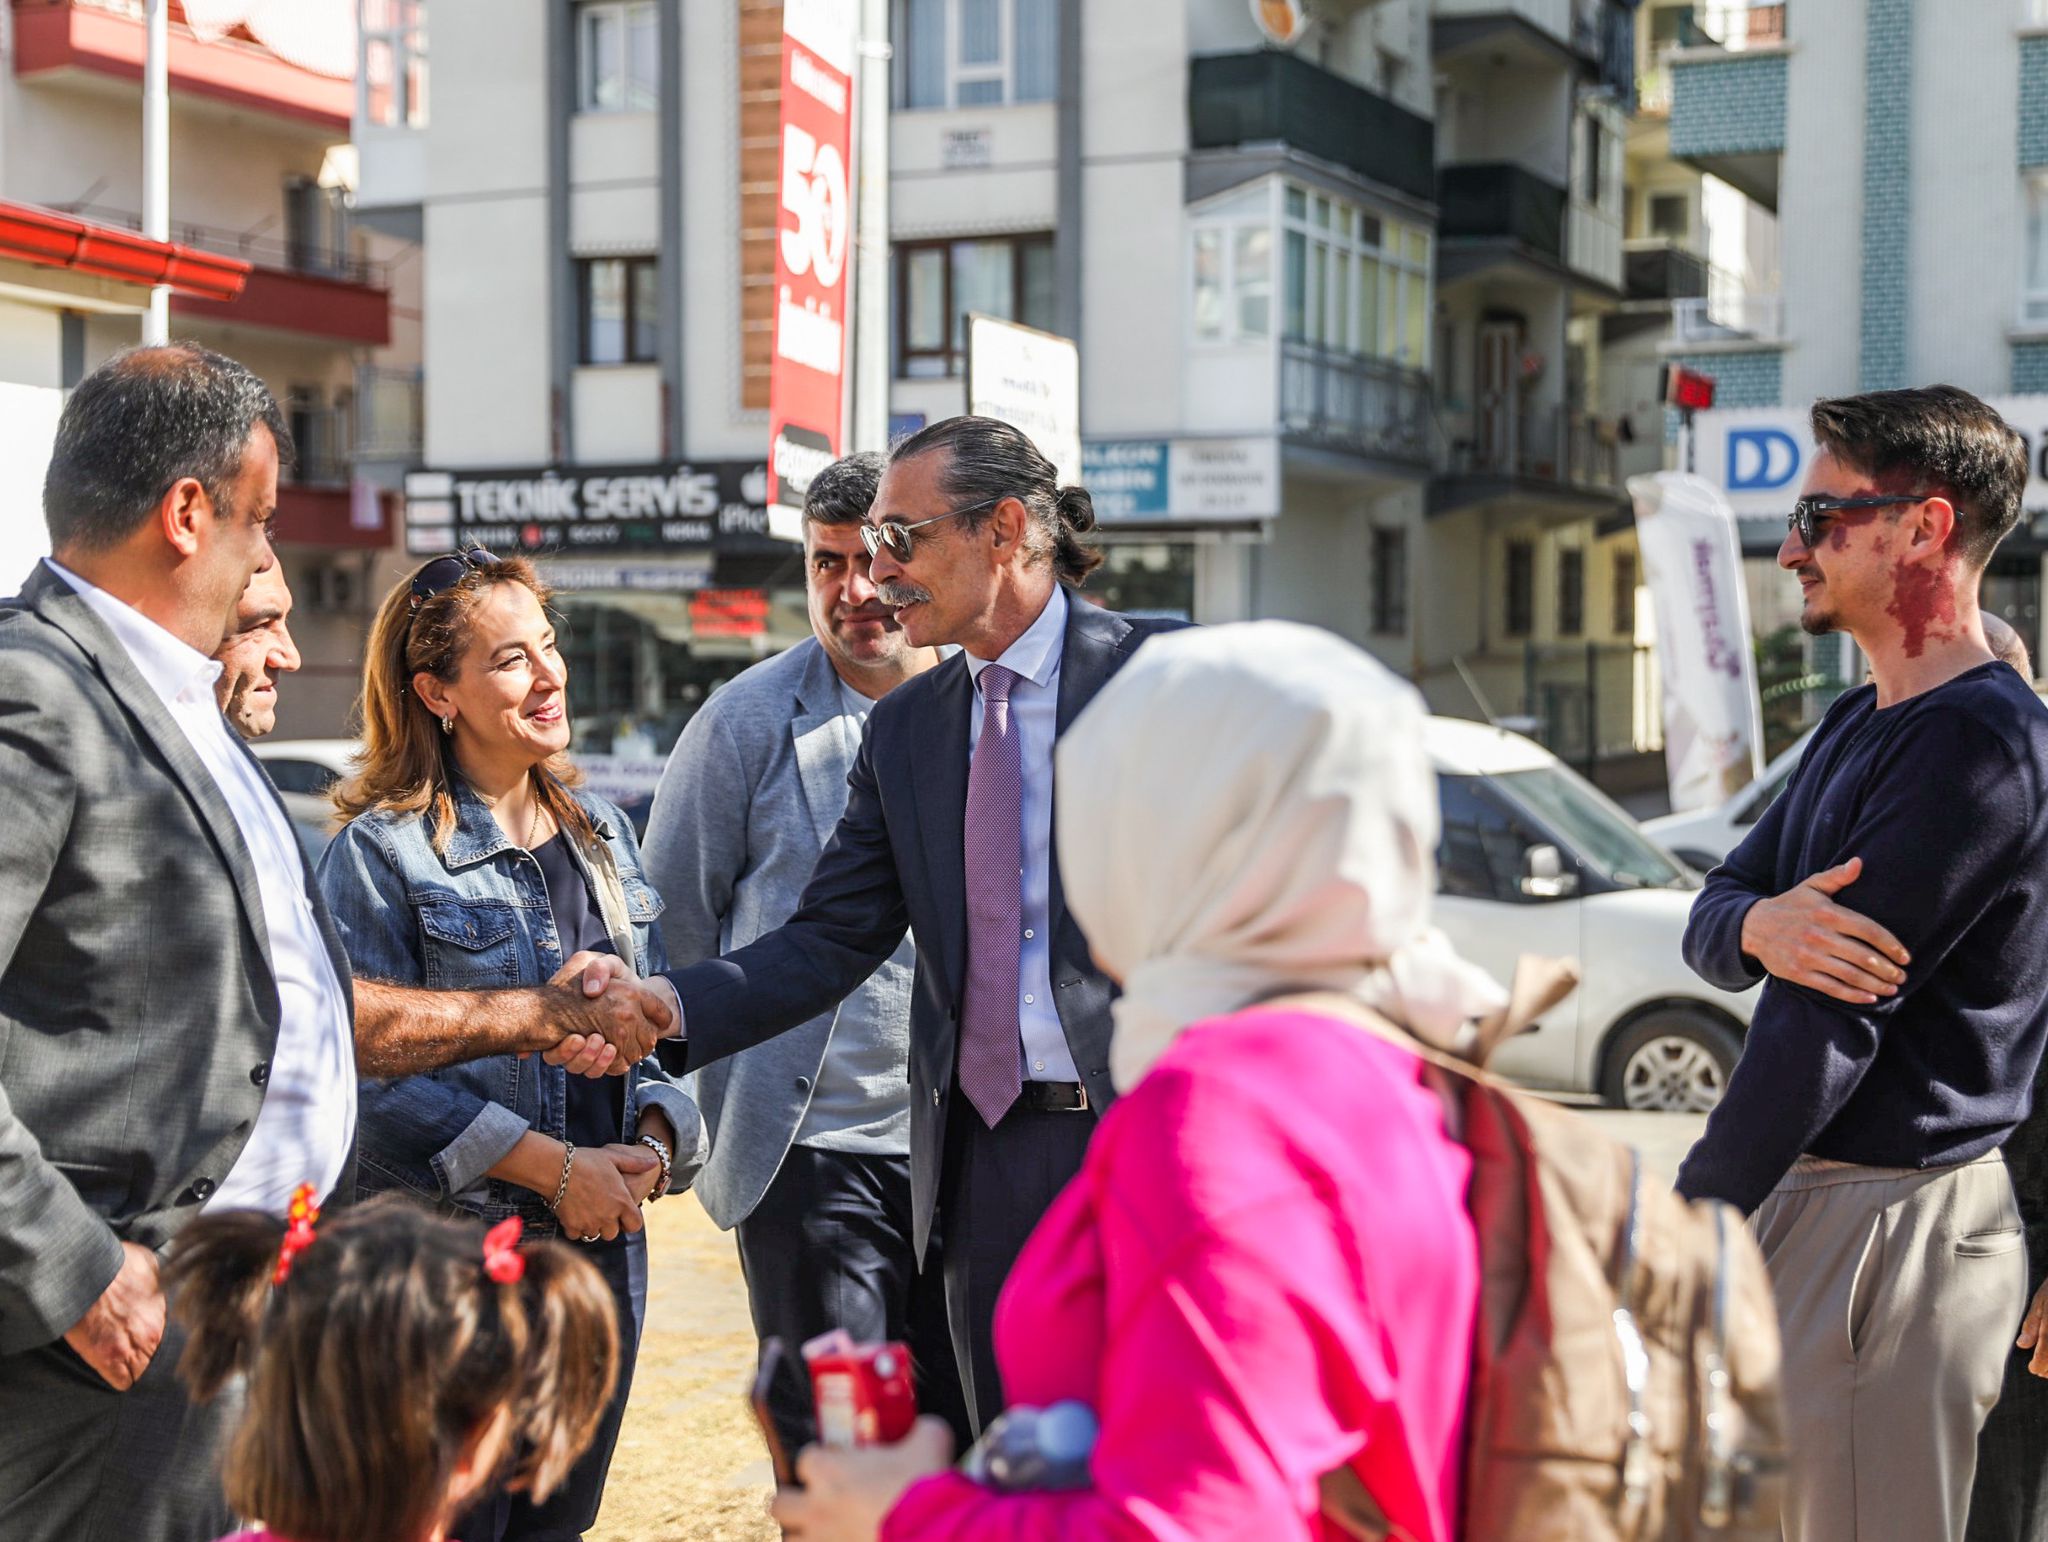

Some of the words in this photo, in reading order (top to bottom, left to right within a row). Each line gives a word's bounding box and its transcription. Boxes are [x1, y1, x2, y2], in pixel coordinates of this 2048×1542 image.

[781, 122, 847, 288] 50
[453, 470, 579, 521] TEKNİK
[582, 465, 718, 518] SERVİS
